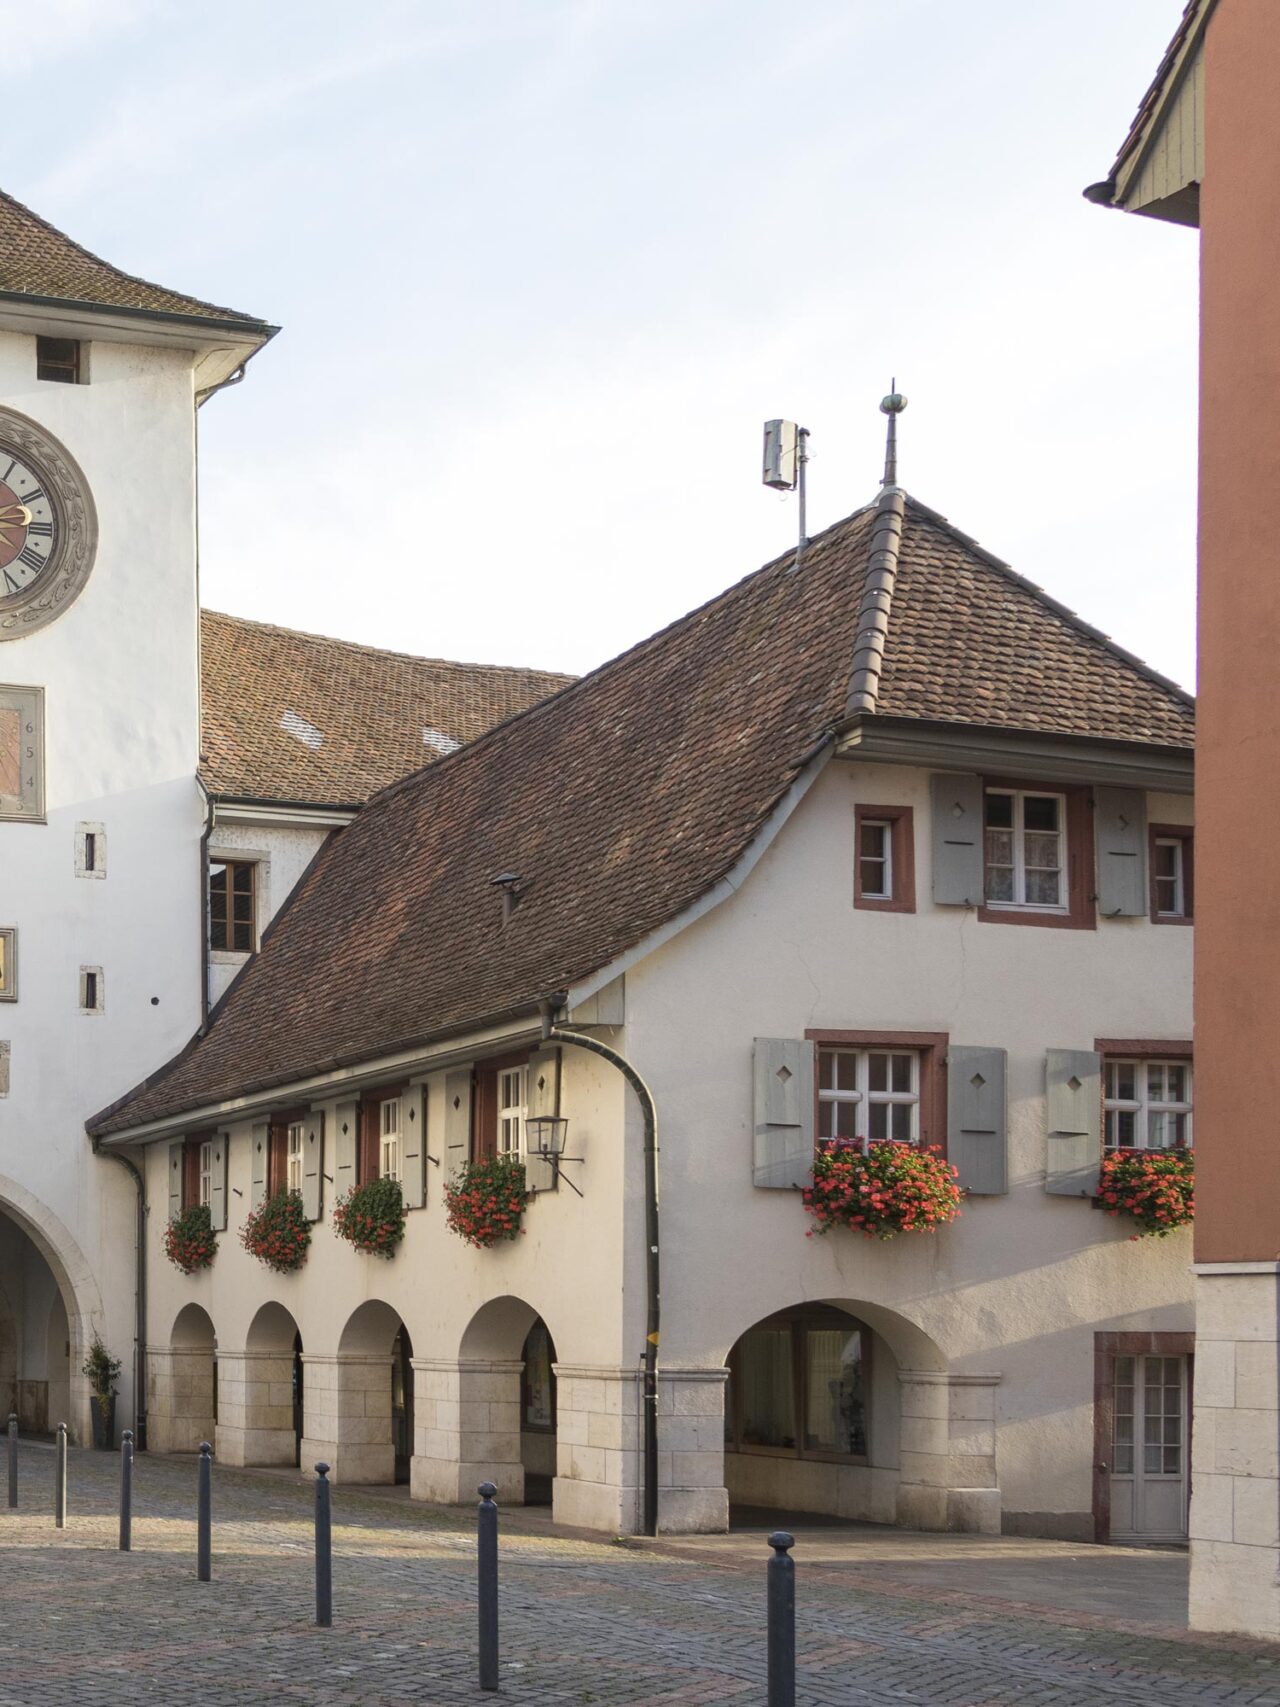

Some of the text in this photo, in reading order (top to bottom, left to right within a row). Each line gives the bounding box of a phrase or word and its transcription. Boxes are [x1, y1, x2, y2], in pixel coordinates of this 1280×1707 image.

[1, 460, 17, 481] I
[21, 487, 44, 505] II
[29, 522, 52, 537] III
[17, 544, 47, 573] IIII
[3, 570, 20, 593] V
[26, 723, 33, 733] 6
[27, 747, 33, 758] 5
[26, 777, 33, 787] 4
